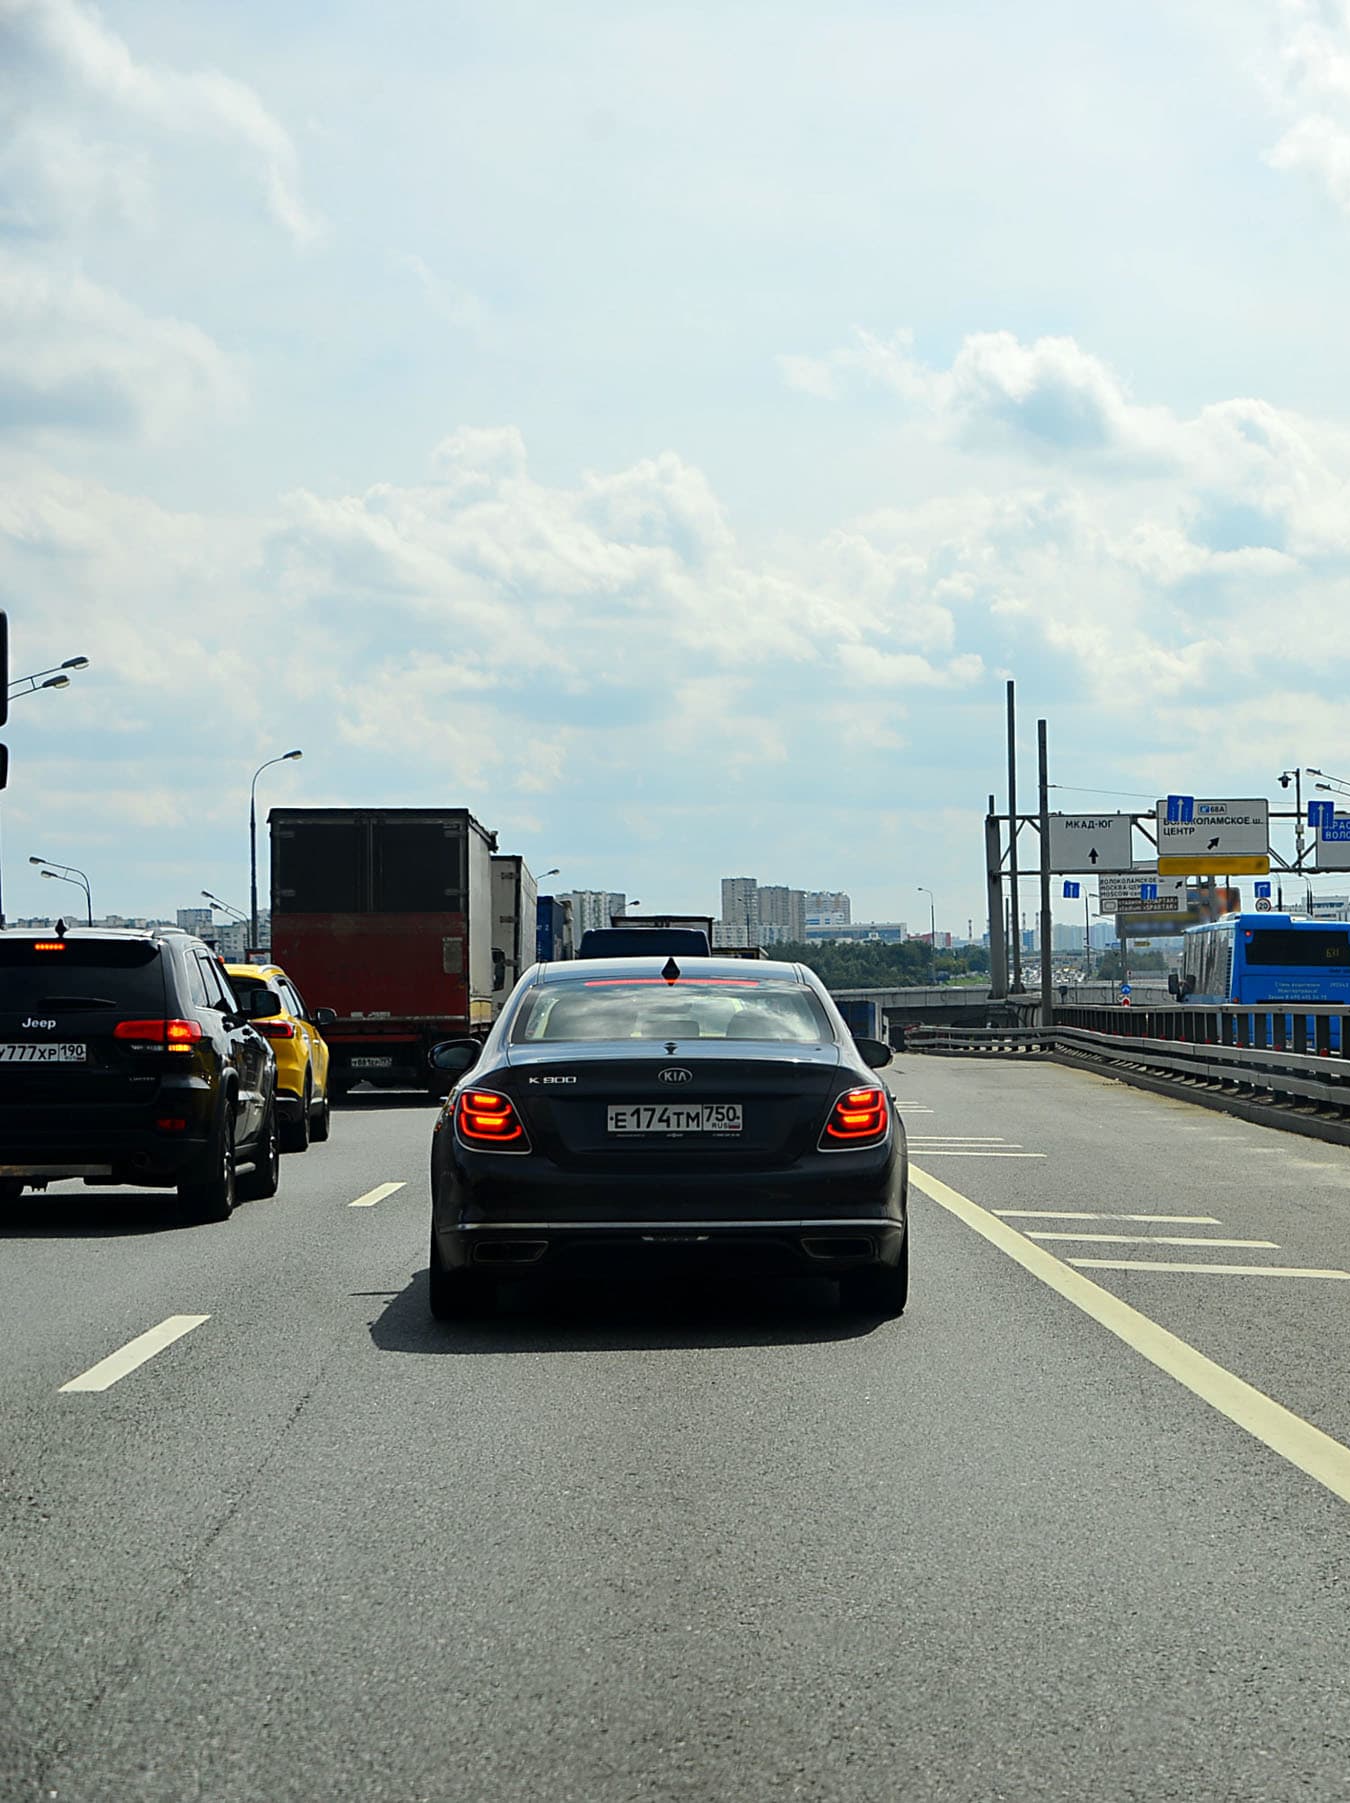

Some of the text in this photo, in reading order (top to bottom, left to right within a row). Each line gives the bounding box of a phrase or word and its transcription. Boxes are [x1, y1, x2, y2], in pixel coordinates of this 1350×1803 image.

[1065, 820, 1114, 829] МКАД-ЮГ
[1163, 827, 1195, 836] ЦЕНТР
[1259, 902, 1268, 910] 20
[22, 1017, 57, 1030] Jeep
[60, 1044, 84, 1057] 190
[663, 1071, 688, 1082] KIA
[704, 1105, 737, 1122] 750
